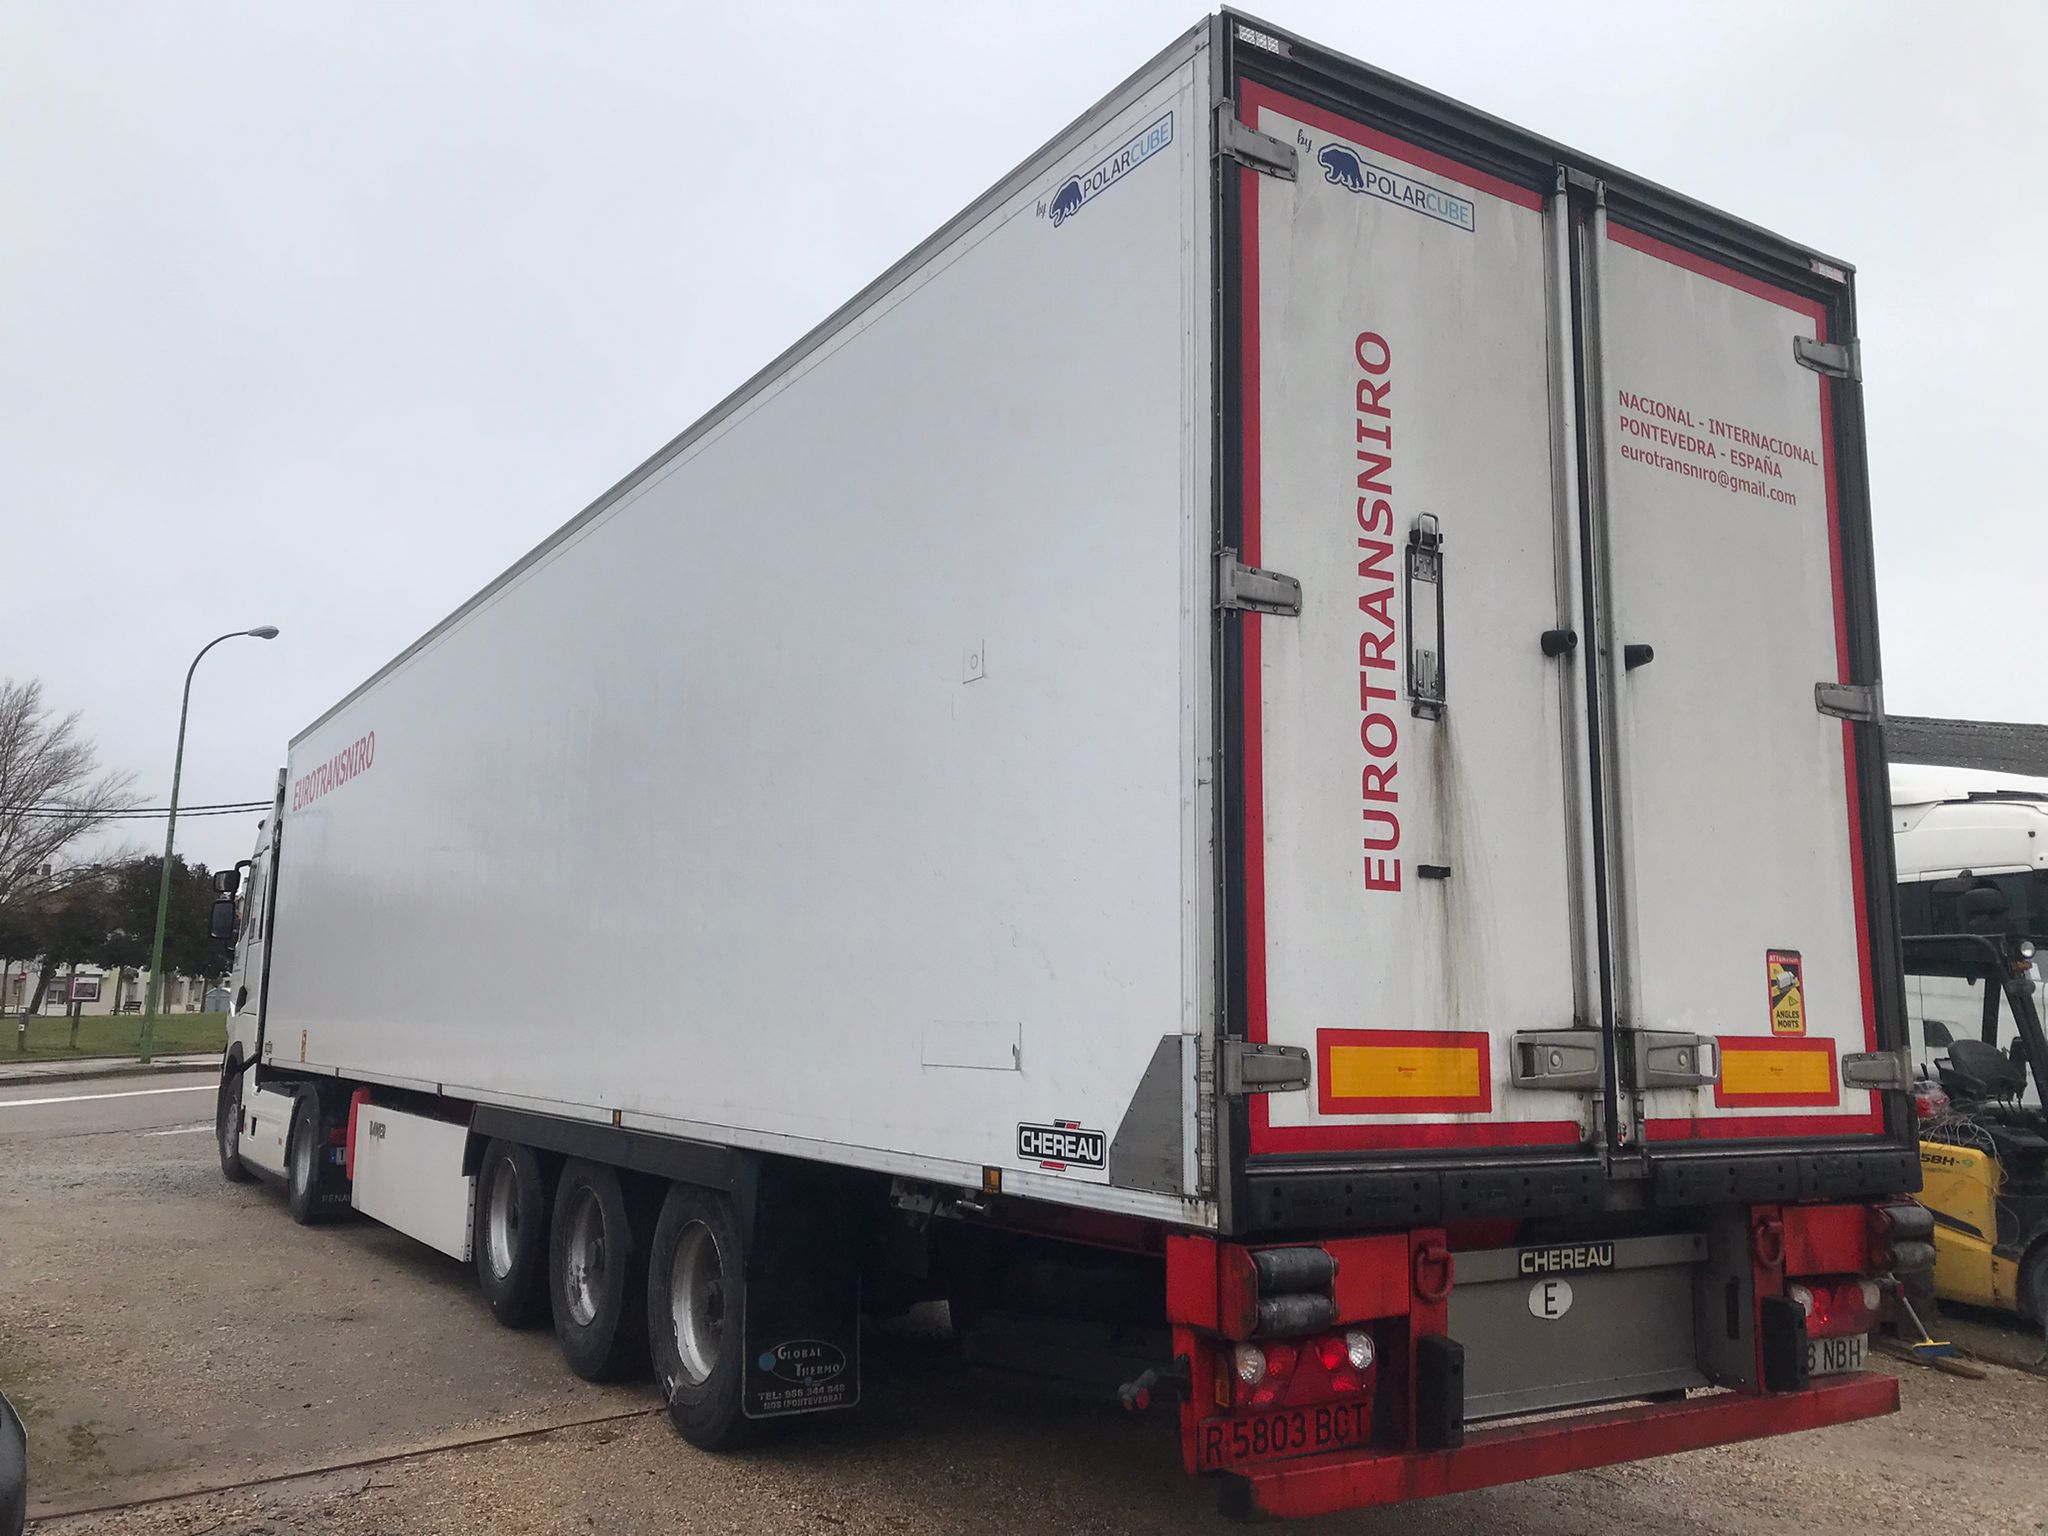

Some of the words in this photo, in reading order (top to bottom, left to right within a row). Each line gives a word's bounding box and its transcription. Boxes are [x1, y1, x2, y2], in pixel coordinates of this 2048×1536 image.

[1297, 128, 1312, 153] by
[1083, 117, 1170, 199] POLARCUBE
[1365, 172, 1469, 225] POLARCUBE
[1618, 390, 1695, 428] NACIONAL
[1708, 417, 1819, 466] INTERNACIONAL
[1620, 415, 1716, 459] PONTEVEDRA
[1730, 449, 1783, 479] ESPAÑA
[1621, 444, 1797, 506] eurotransniro@gmail.com
[1355, 330, 1402, 894] EUROTRANSNIRO
[292, 731, 375, 812] EUROTRANSNIRO
[1776, 1010, 1800, 1019] ANGLES
[1777, 1020, 1800, 1029] MORTS
[1020, 1130, 1101, 1161] CHEREAU
[1520, 1245, 1613, 1274] CHEREAU
[1544, 1282, 1558, 1316] E
[777, 1346, 822, 1360] GLOBAL
[1823, 1339, 1861, 1370] NBH
[794, 1362, 841, 1377] THERMO
[758, 1391, 783, 1402] TEL:
[1315, 1402, 1369, 1446] BCT
